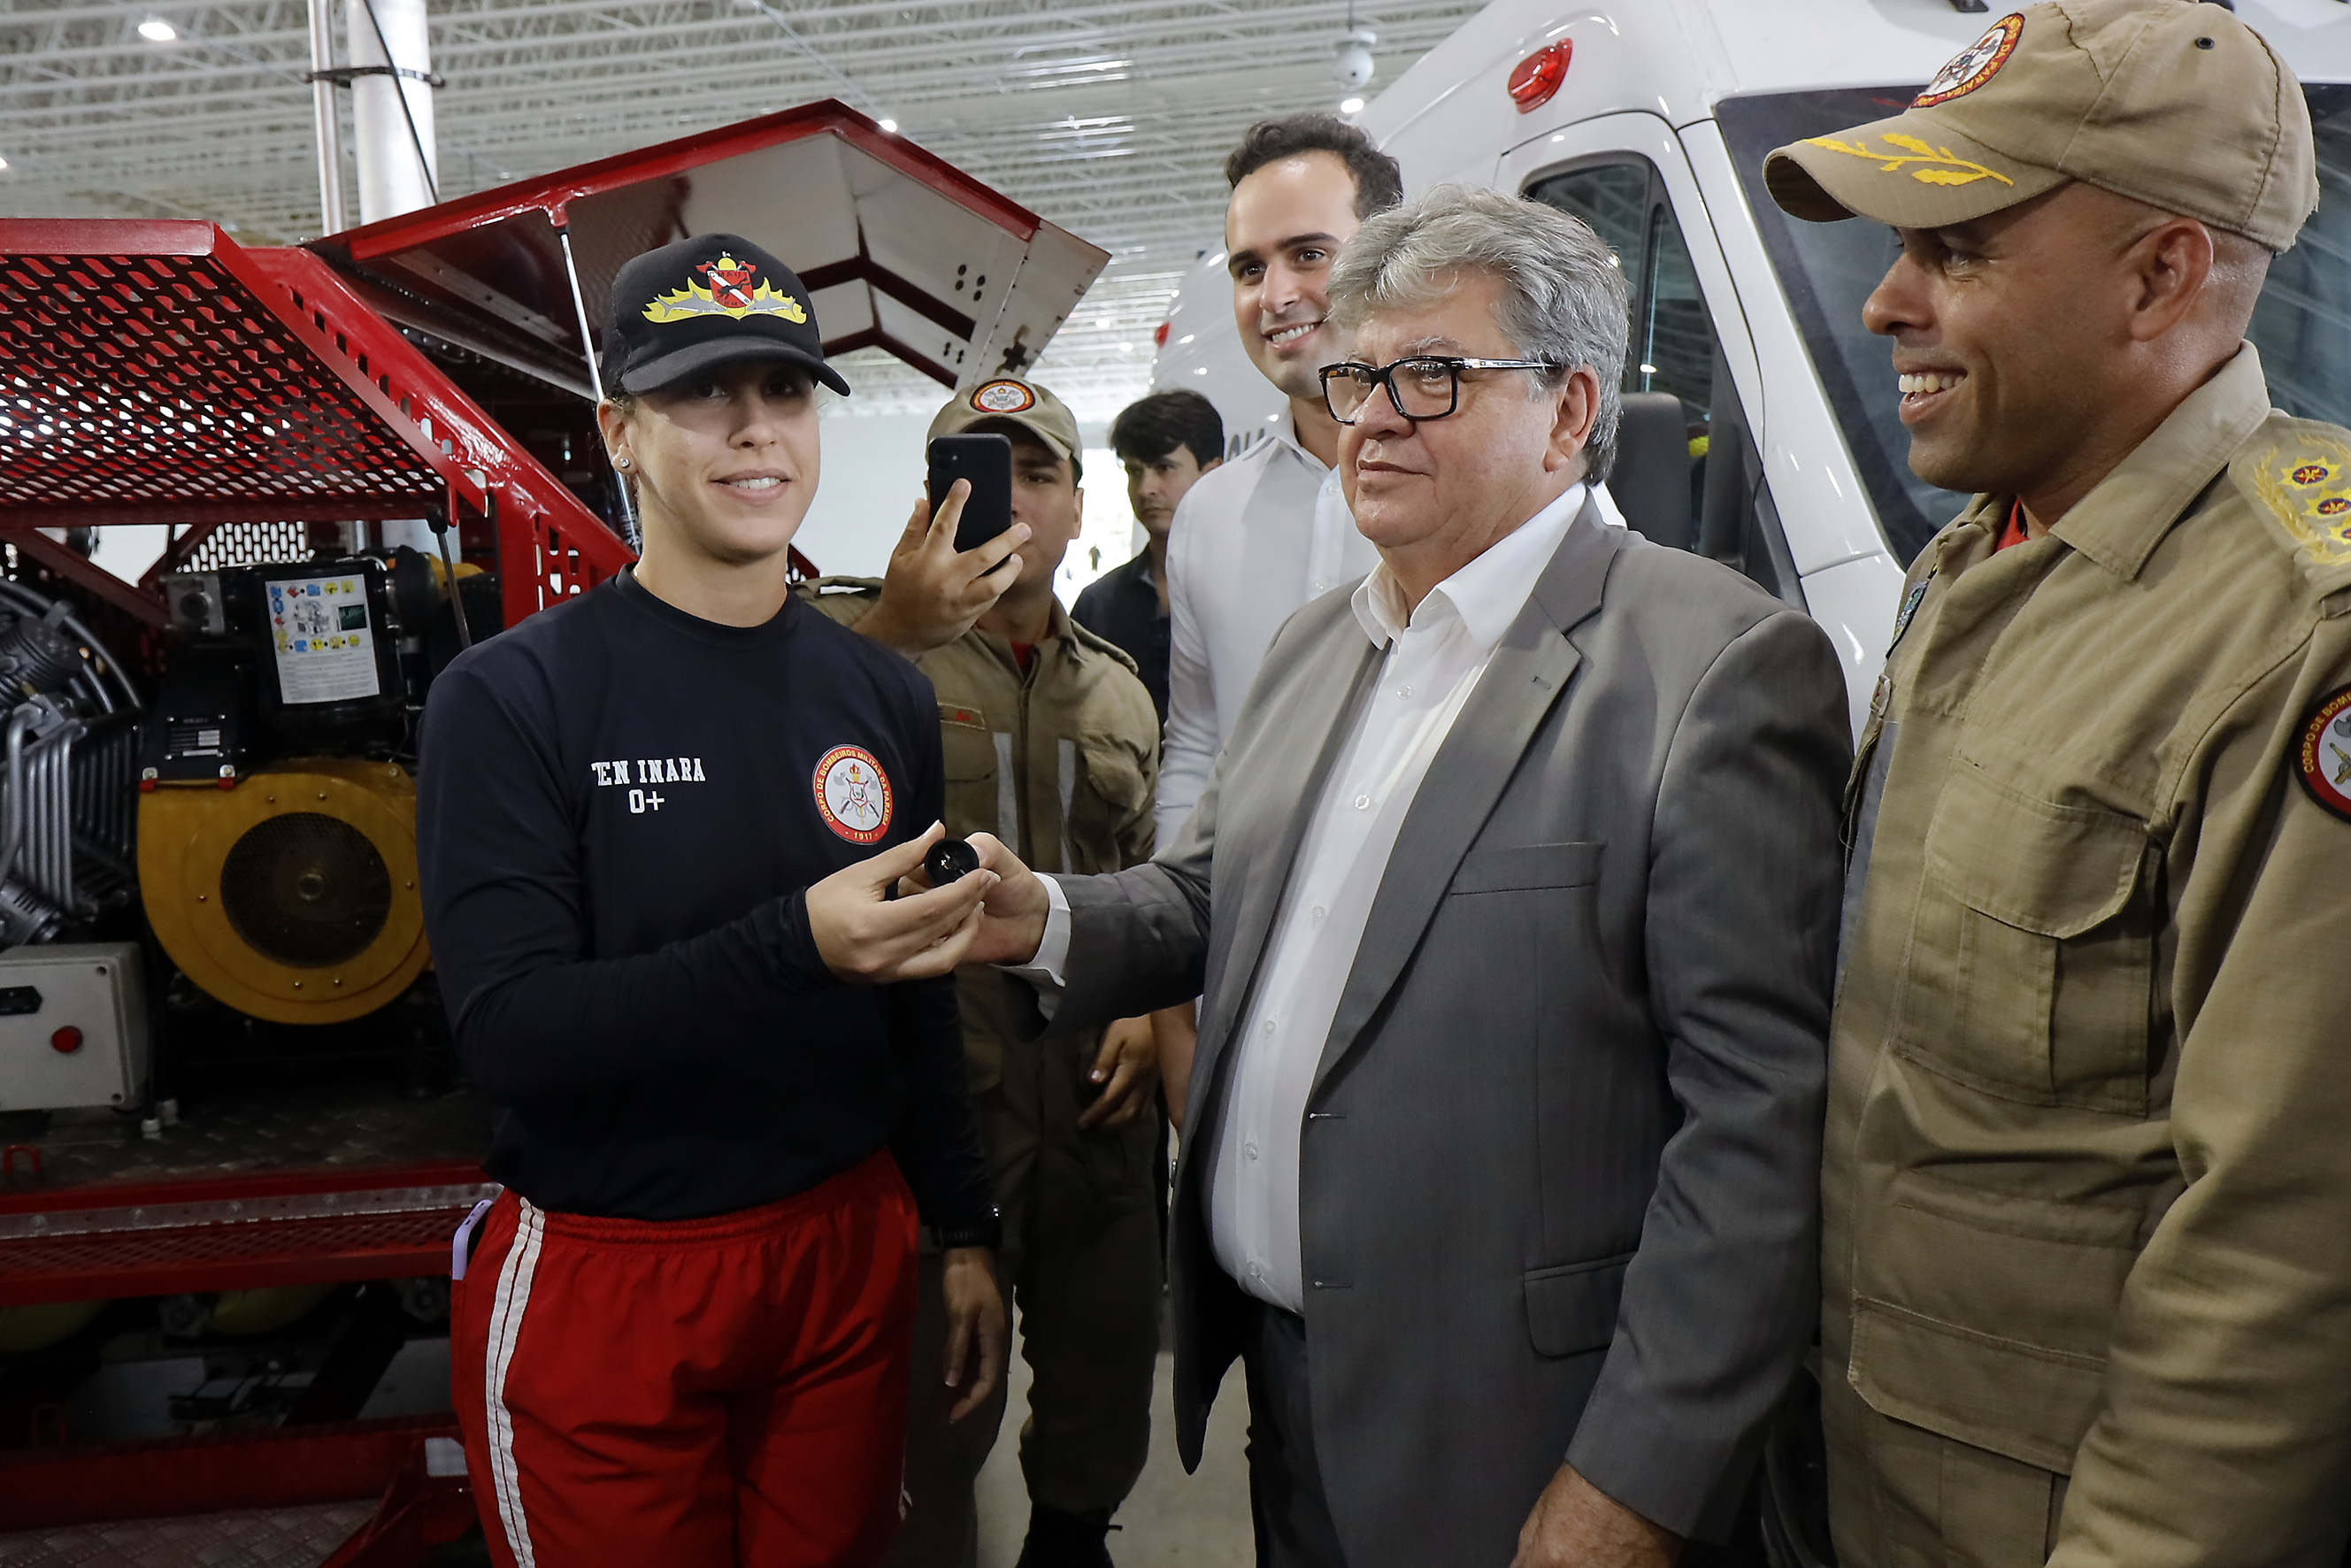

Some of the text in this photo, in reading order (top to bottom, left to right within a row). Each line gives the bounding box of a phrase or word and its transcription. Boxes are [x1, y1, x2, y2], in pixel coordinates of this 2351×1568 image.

[2302, 733, 2316, 773] CORPO
[2309, 716, 2324, 732] DE
[637, 757, 706, 783] INARA
[819, 749, 857, 776] BOMBEIROS
[857, 752, 882, 776] MILITAR
[817, 777, 824, 790] DE
[880, 777, 888, 790] DA
[817, 793, 834, 822] CORPO
